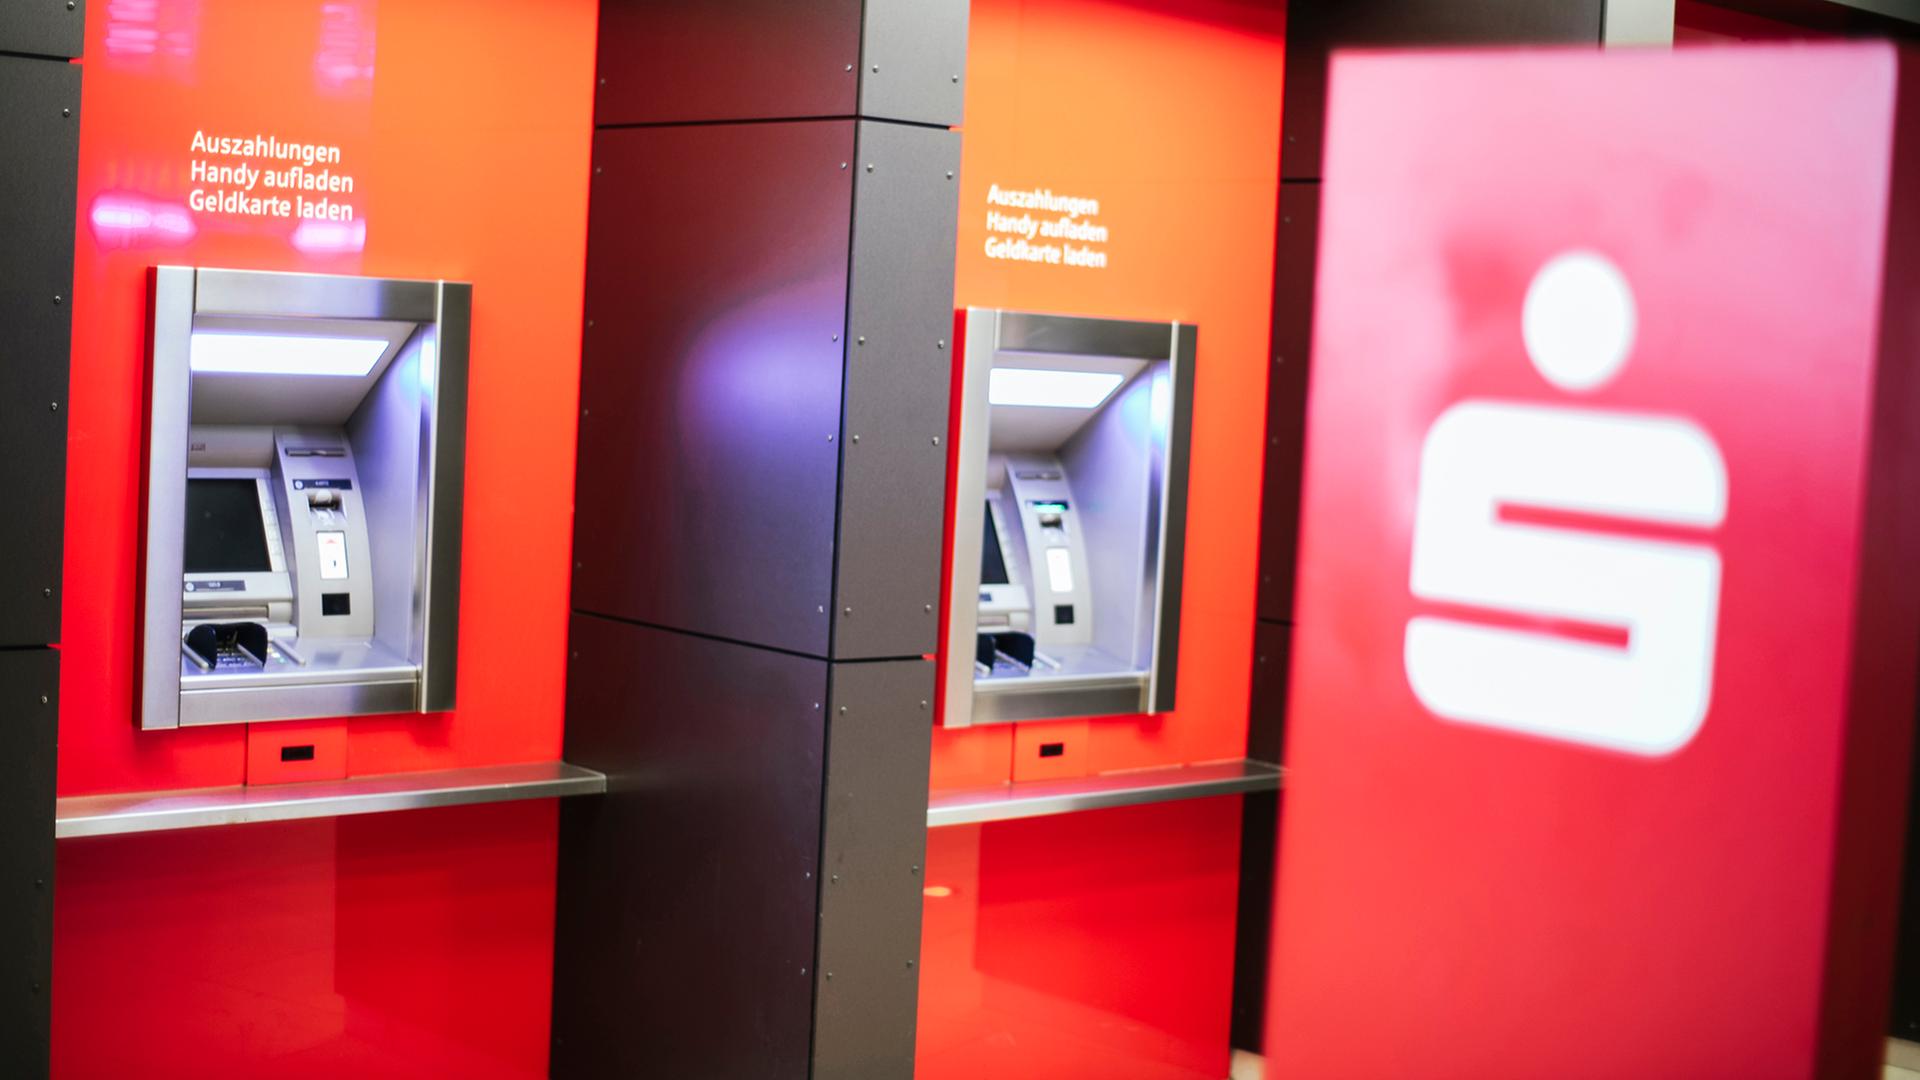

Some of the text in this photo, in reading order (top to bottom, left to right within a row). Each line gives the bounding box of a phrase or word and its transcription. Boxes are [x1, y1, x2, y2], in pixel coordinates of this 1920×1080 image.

[190, 130, 340, 166] Auszahlungen
[191, 159, 353, 193] Handy aufladen
[189, 189, 353, 221] Geldkarte laden
[986, 183, 1100, 218] Auszahlungen
[986, 210, 1109, 243] Handy aufladen
[985, 236, 1108, 268] Geldkarte laden
